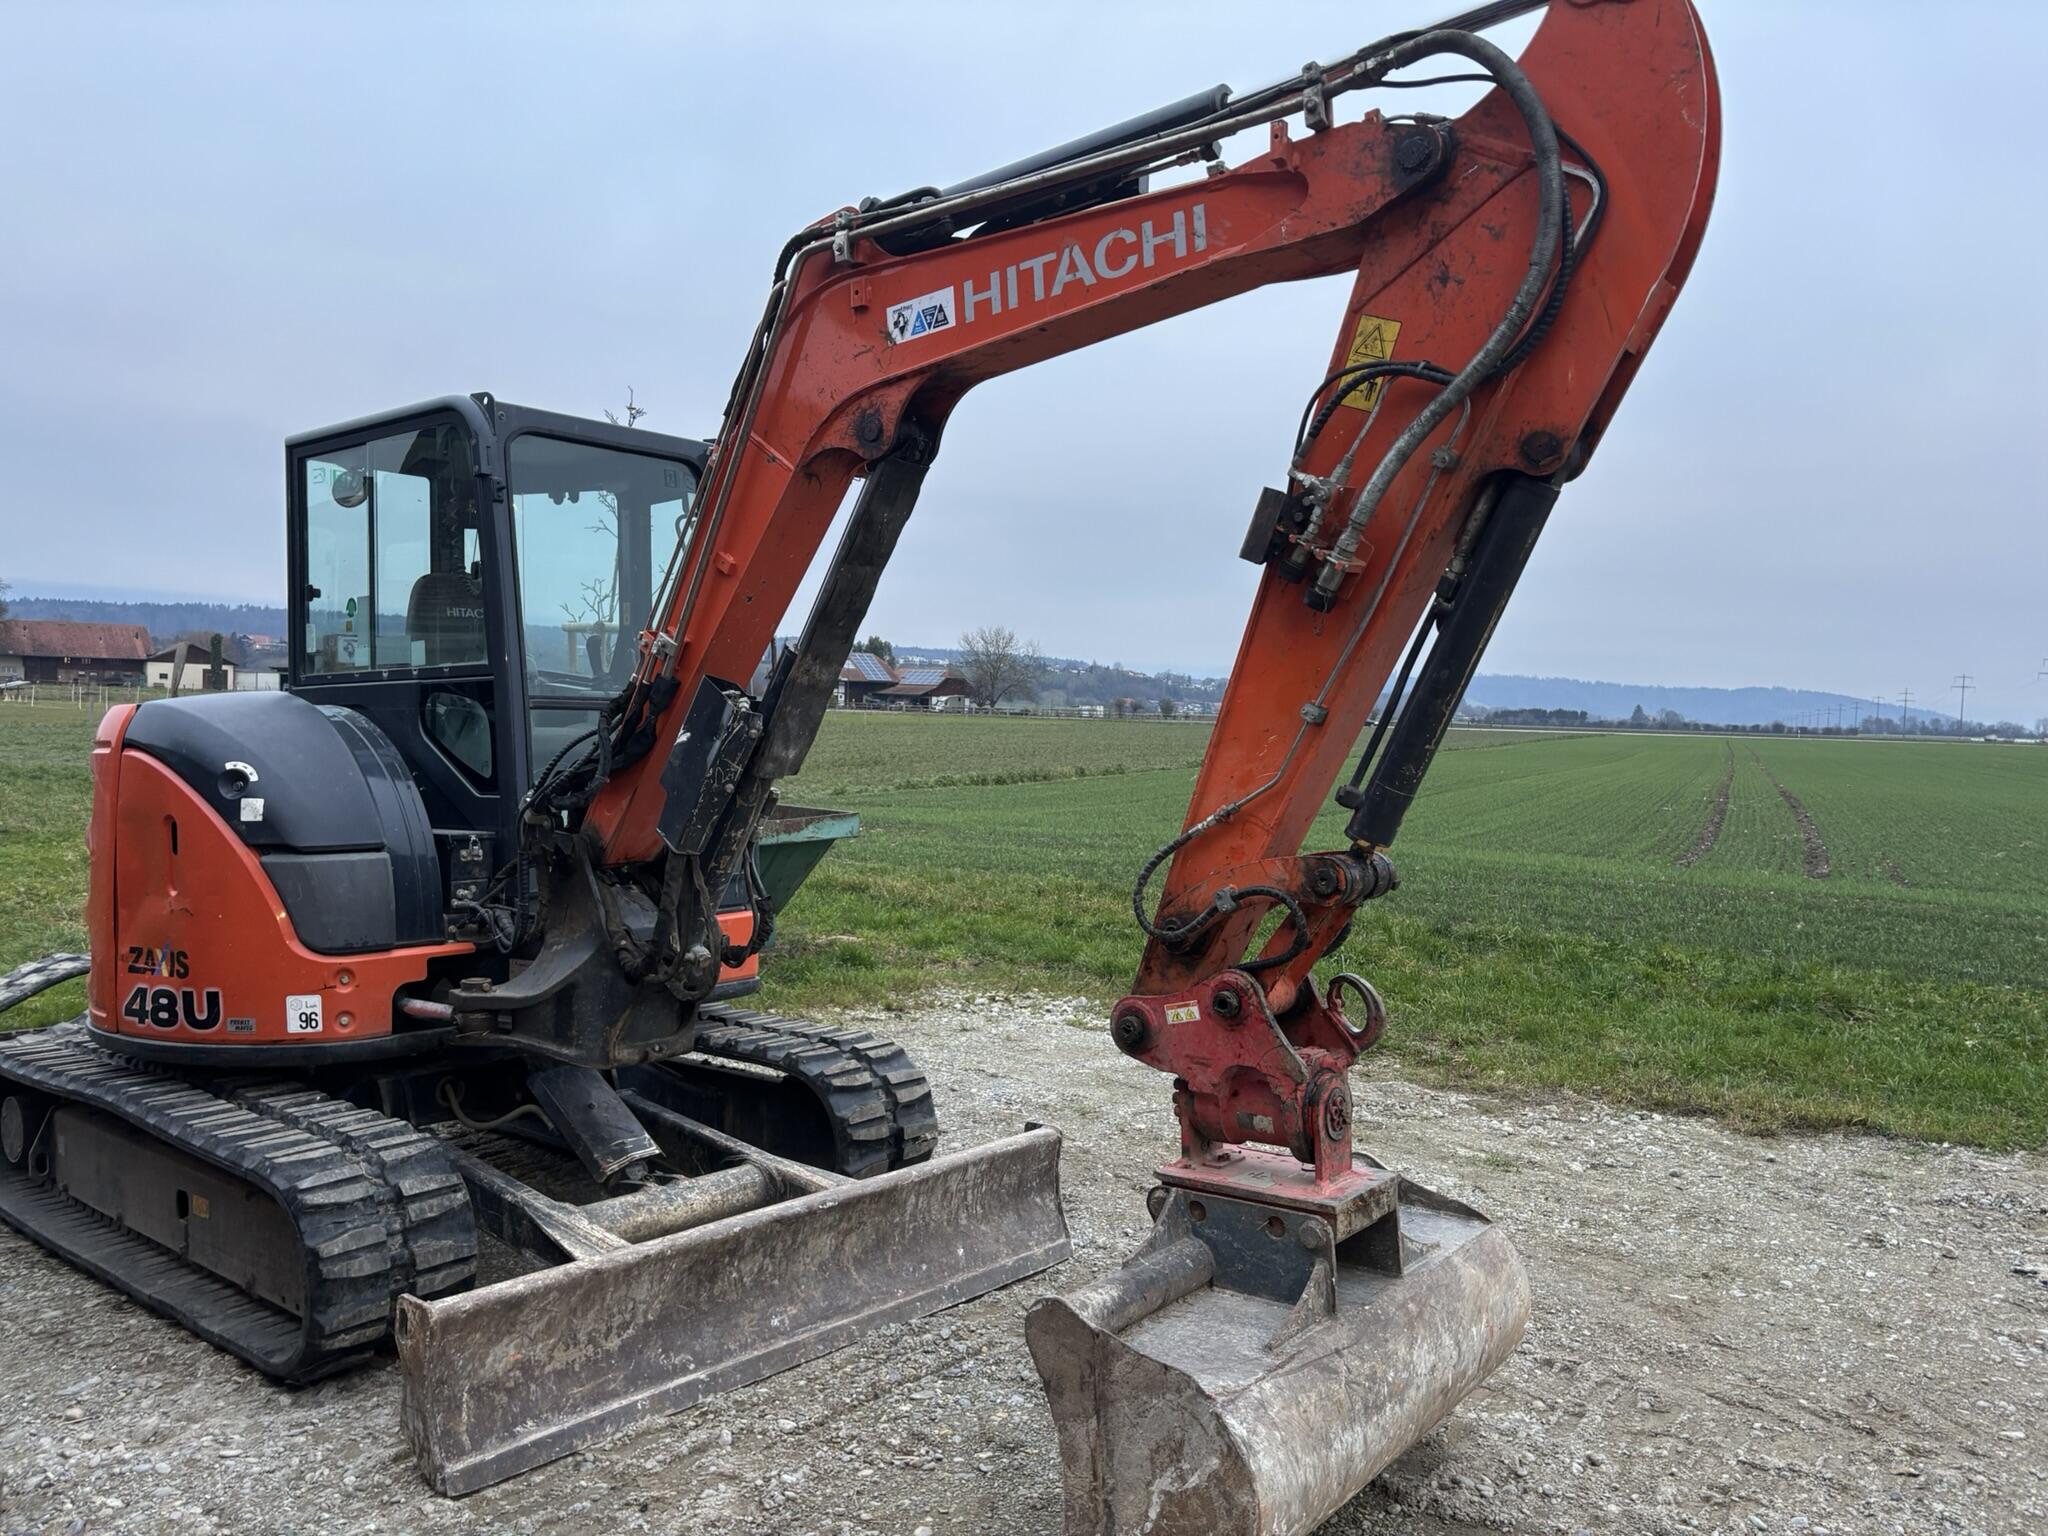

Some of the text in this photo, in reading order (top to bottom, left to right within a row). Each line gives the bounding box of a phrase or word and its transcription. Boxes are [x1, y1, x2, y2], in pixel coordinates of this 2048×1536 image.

[963, 203, 1208, 324] HITACHI
[446, 607, 485, 619] HITAC
[128, 944, 190, 980] ZAXIS
[124, 985, 222, 1033] 48U
[298, 1011, 319, 1030] 96
